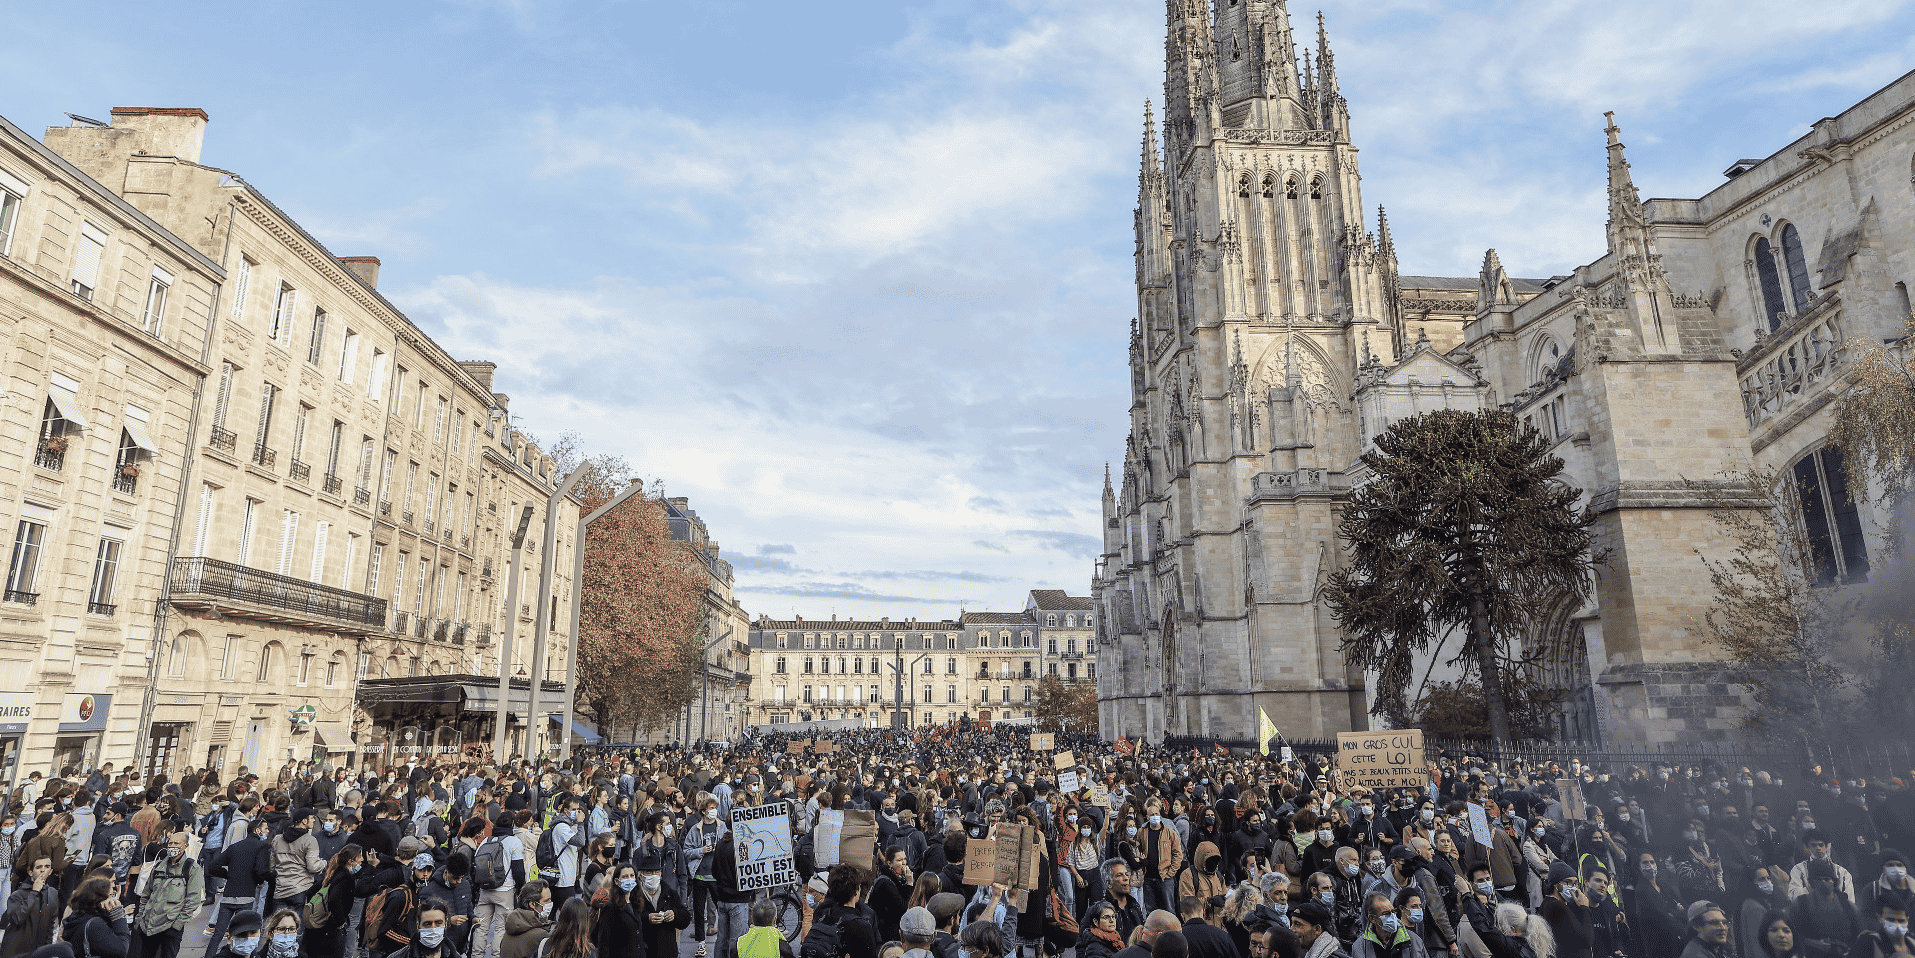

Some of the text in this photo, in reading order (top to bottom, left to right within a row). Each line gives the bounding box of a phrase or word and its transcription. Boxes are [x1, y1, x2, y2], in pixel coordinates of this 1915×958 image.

[0, 706, 30, 716] RAIRES
[1342, 736, 1422, 750] MON GROS CUL
[1351, 754, 1376, 764] CETTE
[1357, 778, 1384, 786] AUTOUR
[733, 804, 786, 822] ENSEMBLE
[738, 858, 792, 876] TOUT EST
[740, 871, 795, 889] POSSIBLE
